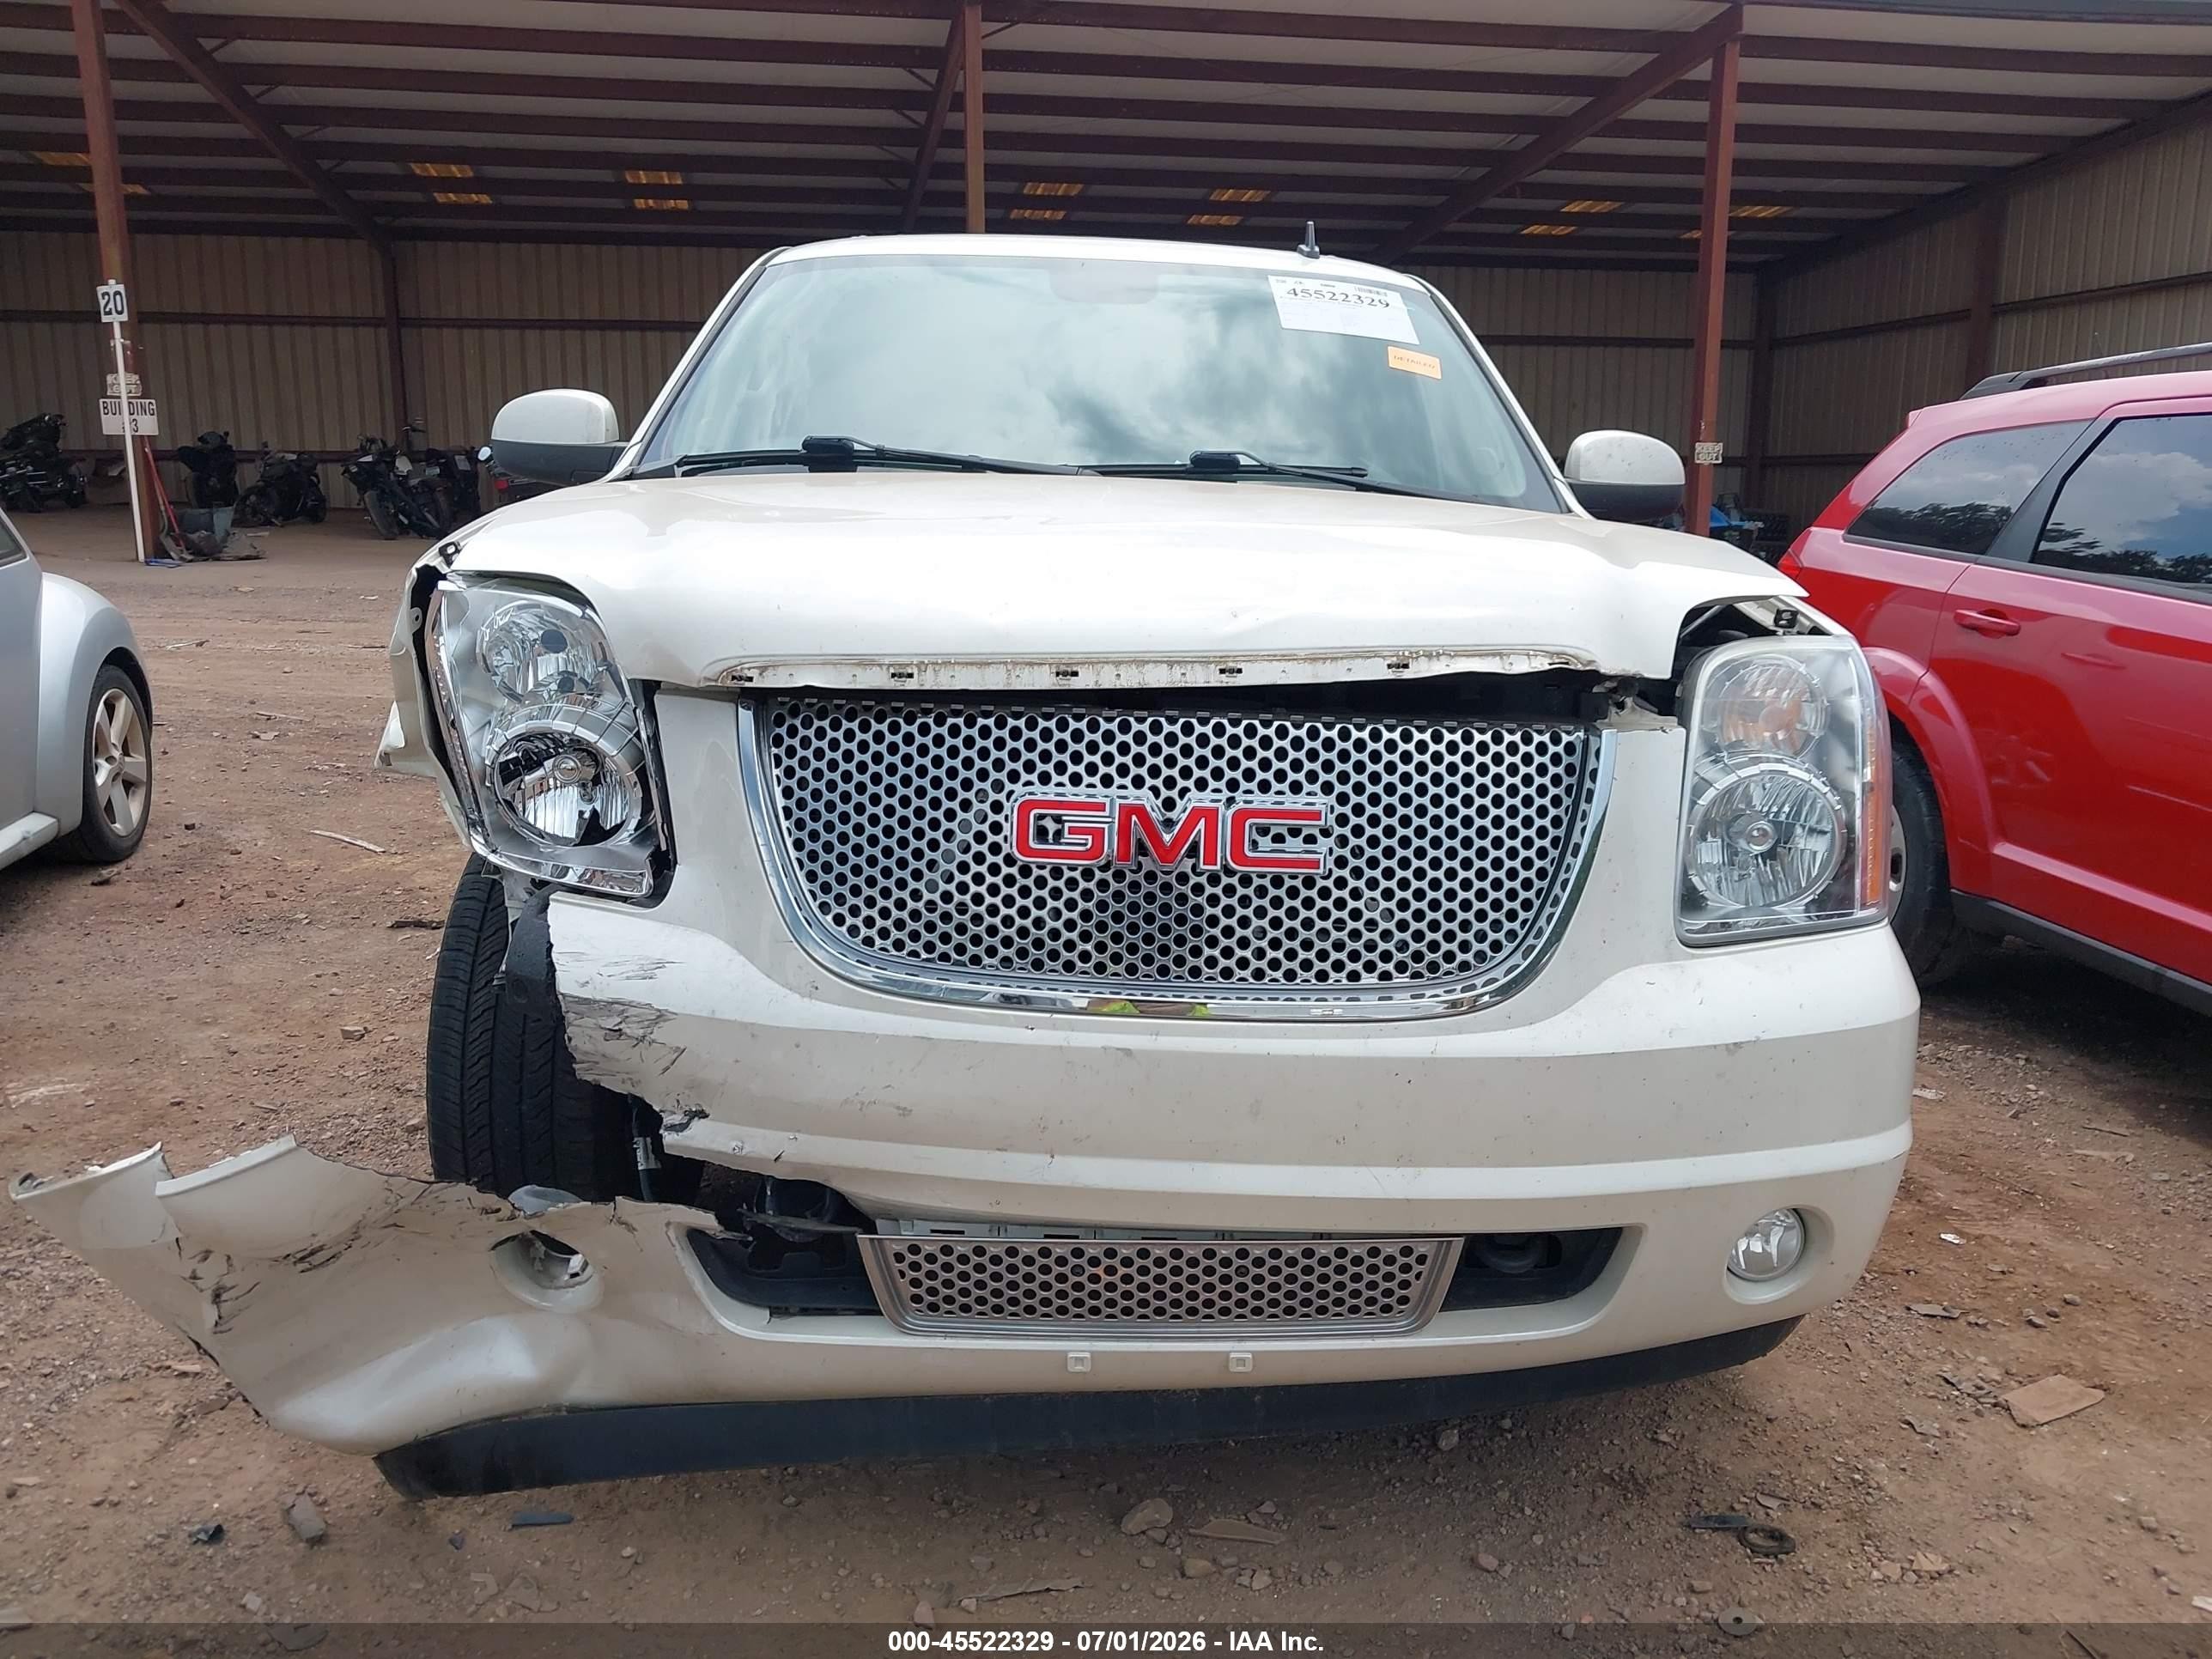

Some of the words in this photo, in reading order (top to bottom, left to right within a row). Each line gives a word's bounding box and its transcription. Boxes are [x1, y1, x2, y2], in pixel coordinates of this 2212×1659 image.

[101, 290, 125, 316] 20
[1287, 288, 1390, 308] 45522329
[102, 400, 155, 416] BUIDING
[1013, 793, 1328, 874] GMC
